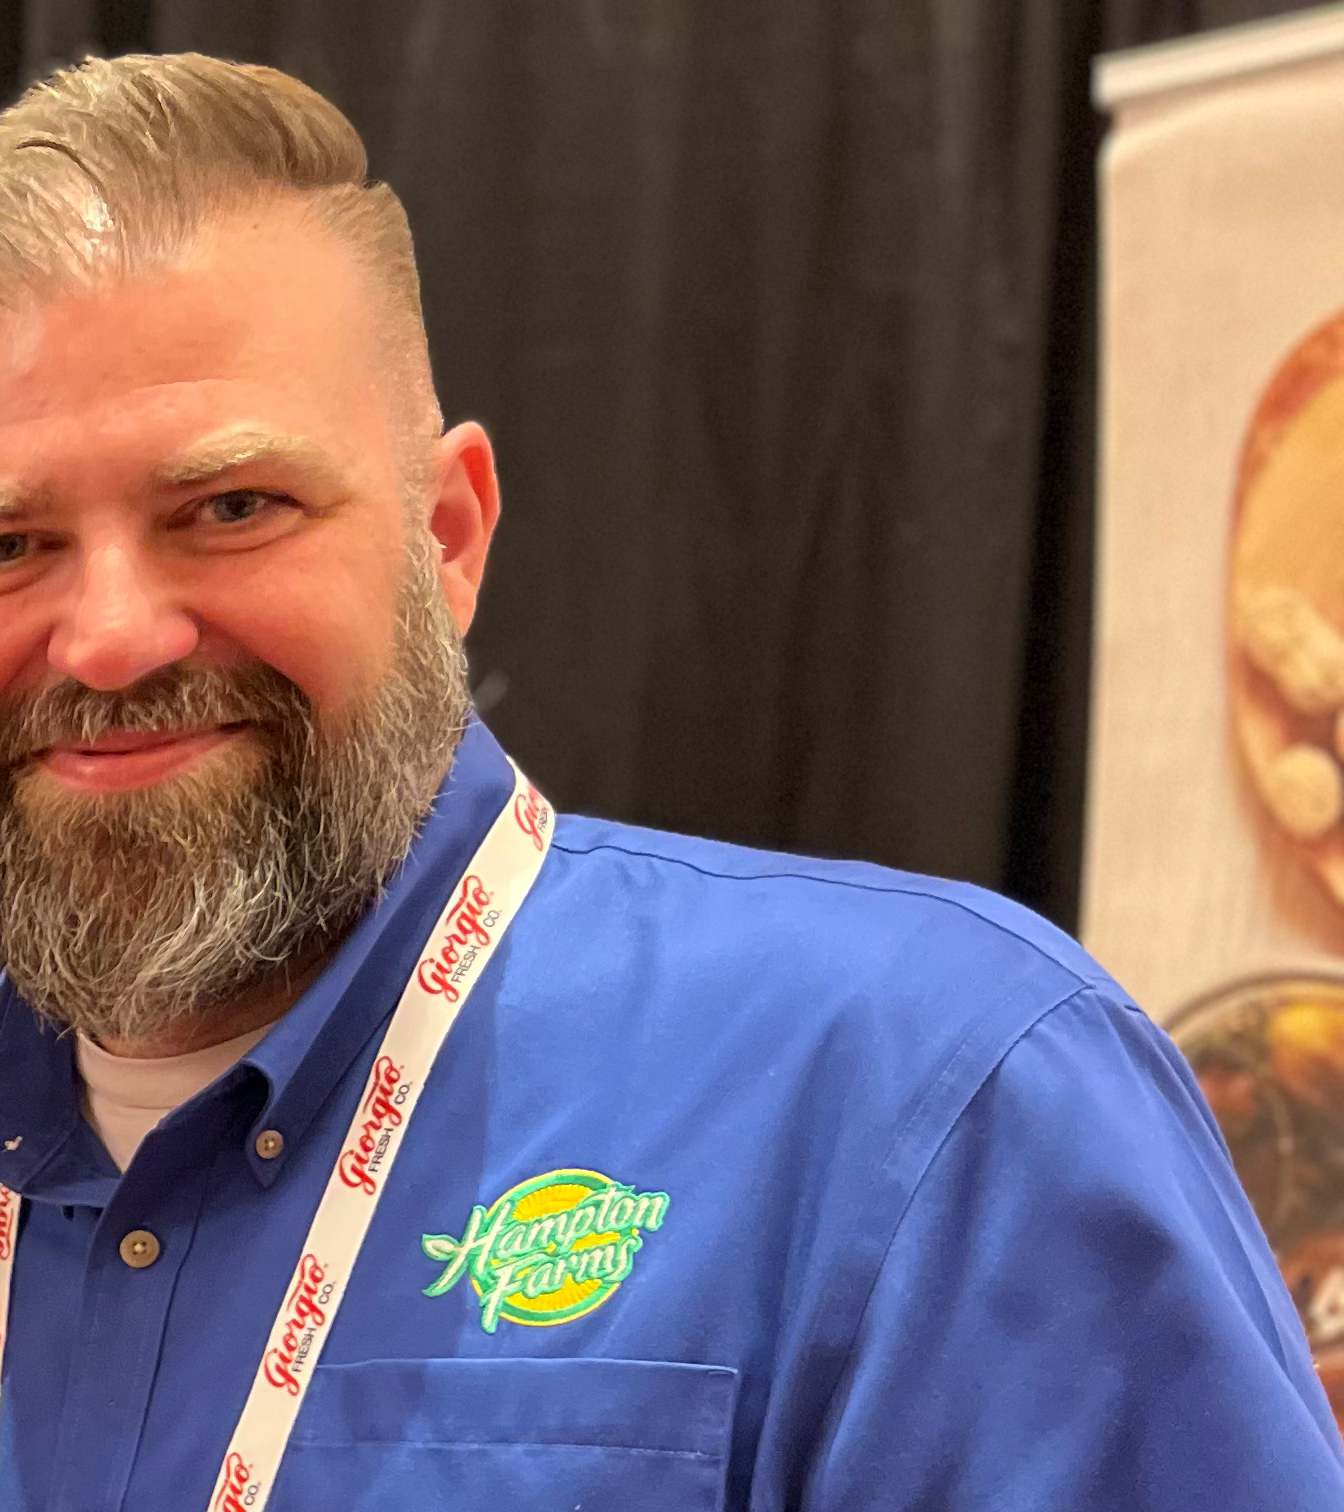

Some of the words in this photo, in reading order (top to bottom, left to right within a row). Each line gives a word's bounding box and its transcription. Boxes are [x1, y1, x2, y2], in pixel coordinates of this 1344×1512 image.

[417, 875, 490, 1003] Giorgio
[451, 944, 481, 984] FRESH
[338, 1056, 402, 1195] Giorgio
[368, 1127, 393, 1173] FRESH
[422, 1181, 670, 1297] Hampton
[481, 1237, 643, 1334] Farms
[264, 1253, 325, 1396] Giorgio
[292, 1327, 317, 1373] FRESH
